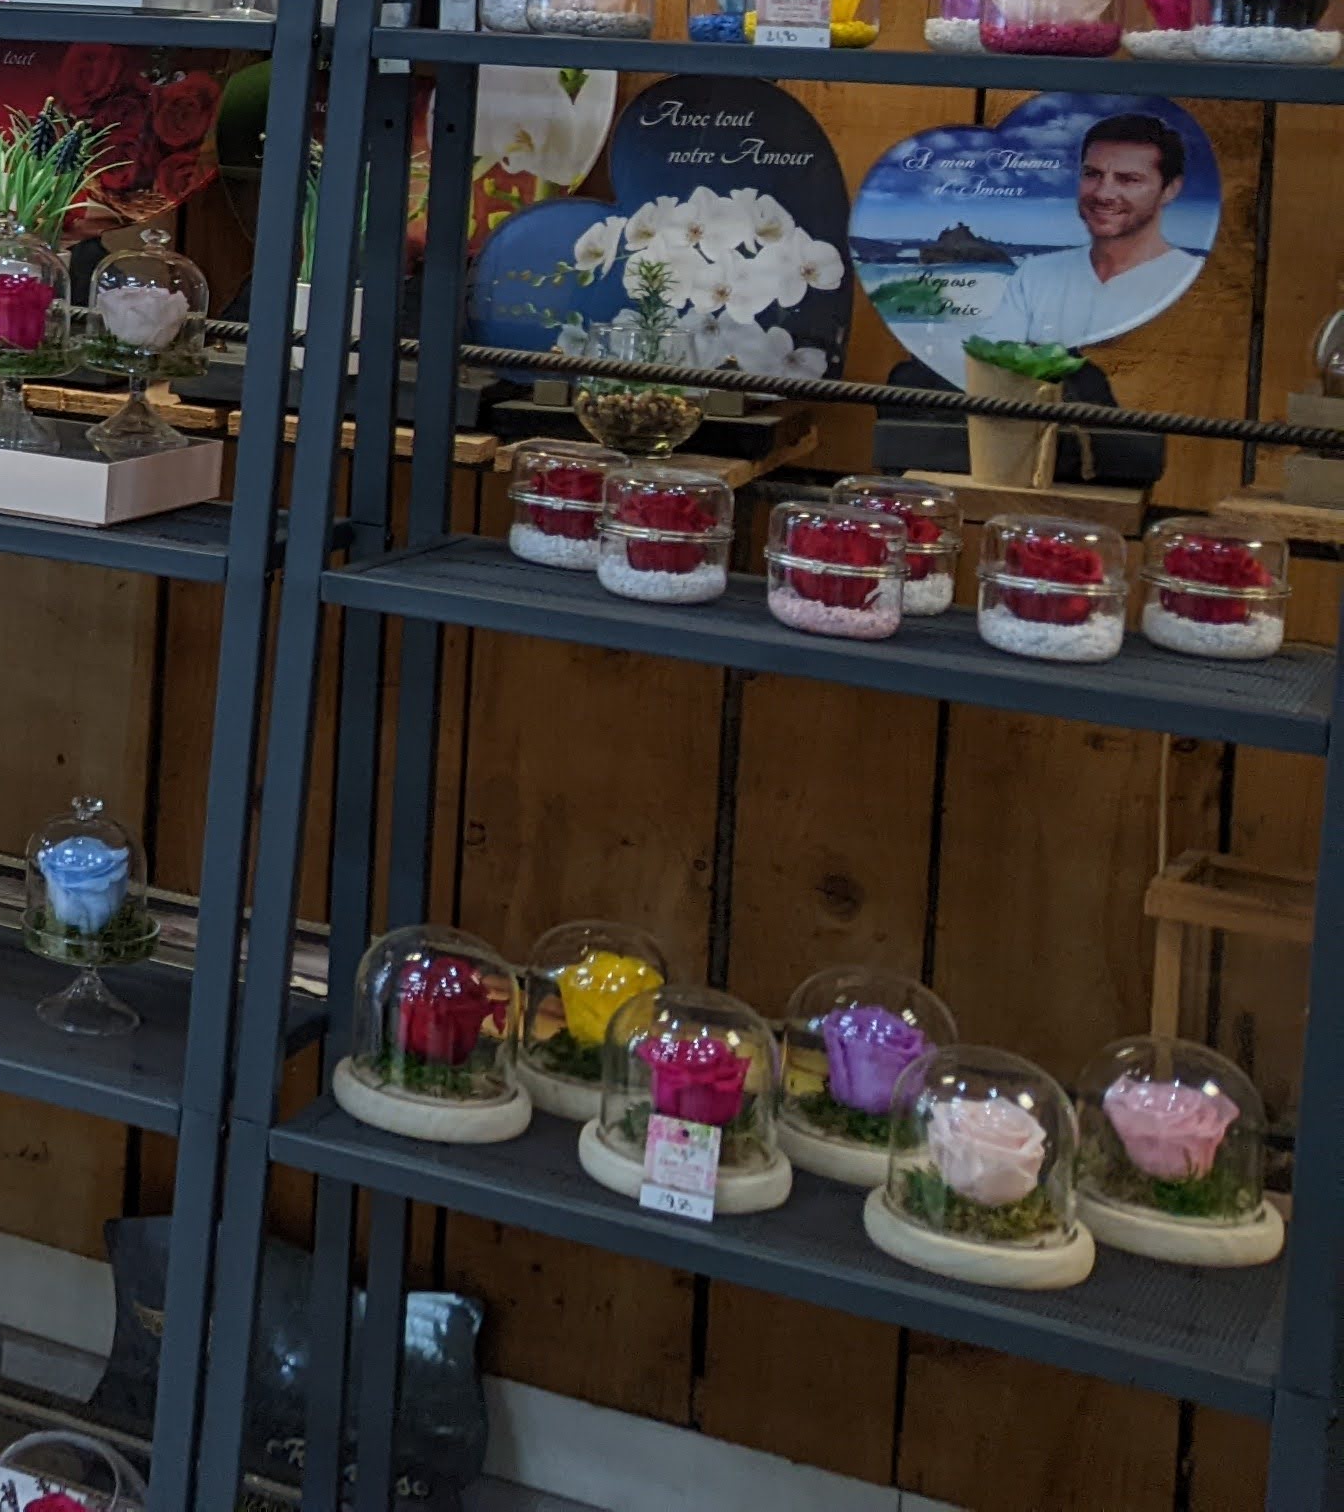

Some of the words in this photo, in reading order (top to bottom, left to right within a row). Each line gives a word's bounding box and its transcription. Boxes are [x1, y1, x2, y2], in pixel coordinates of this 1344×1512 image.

[3, 51, 37, 66] tout
[639, 100, 709, 128] Avec
[715, 110, 755, 127] tout
[668, 147, 715, 164] notre
[720, 138, 815, 166] Amour
[939, 157, 977, 170] mon
[985, 148, 1063, 172] Thomas
[917, 270, 978, 295] Repose
[929, 299, 983, 318] Paix
